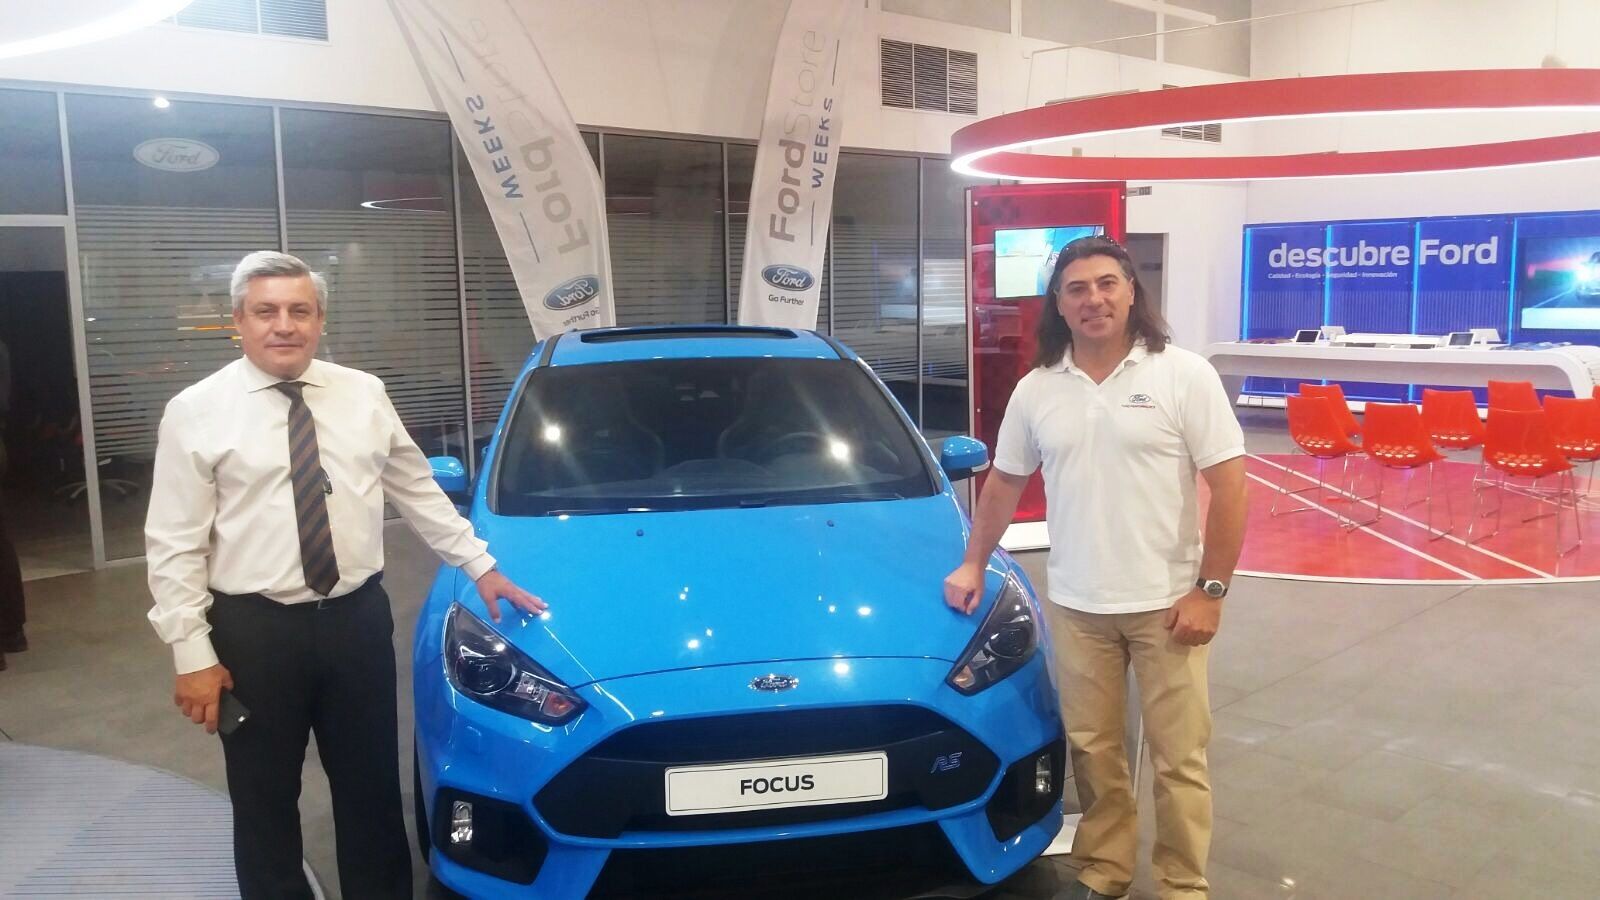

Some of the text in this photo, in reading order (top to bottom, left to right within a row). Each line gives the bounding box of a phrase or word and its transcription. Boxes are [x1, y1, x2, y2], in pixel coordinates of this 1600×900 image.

[152, 143, 202, 165] Ford
[811, 96, 834, 190] WEEKS
[1268, 235, 1499, 268] descubre Ford
[771, 267, 807, 288] Ford
[768, 294, 805, 306] Go Further
[740, 774, 815, 796] FOCUS
